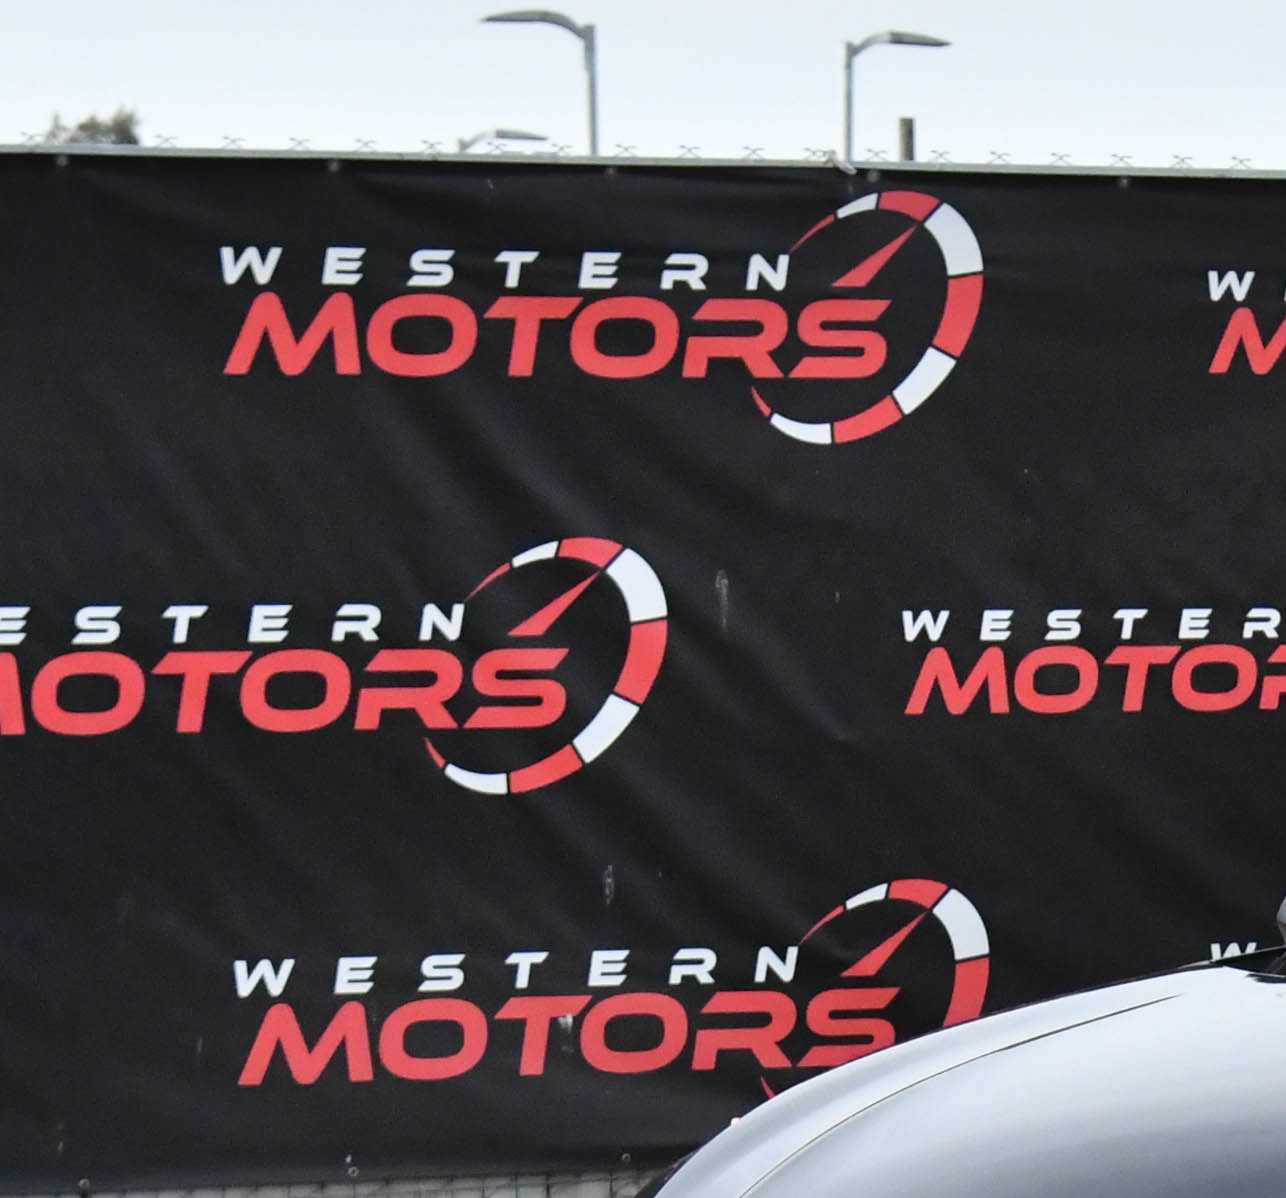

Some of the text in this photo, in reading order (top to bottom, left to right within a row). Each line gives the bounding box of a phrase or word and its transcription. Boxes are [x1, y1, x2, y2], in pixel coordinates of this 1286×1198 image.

[222, 246, 790, 291] WESTERN
[224, 291, 890, 378] MOTORS
[0, 648, 568, 735] OTORS
[233, 946, 799, 997] WESTERN
[238, 987, 900, 1085] MOTORS
